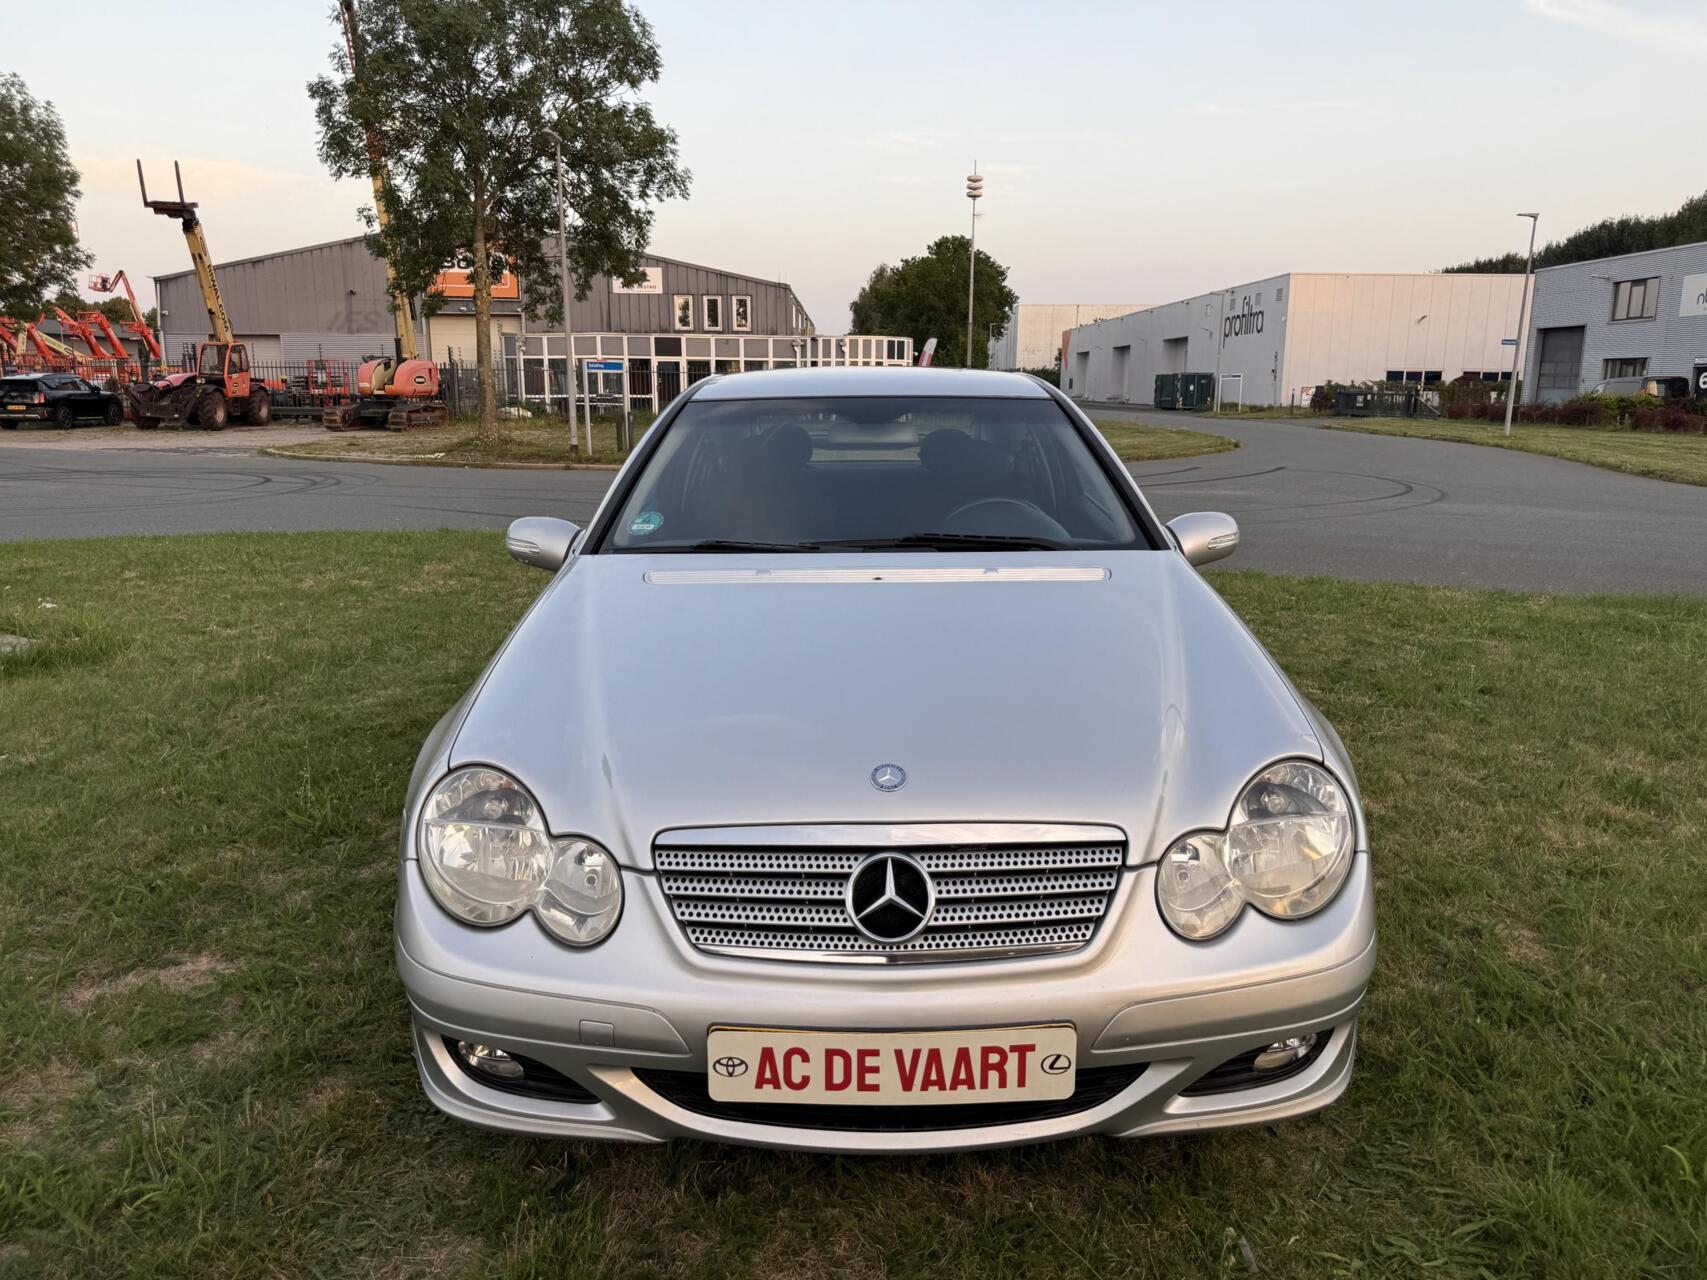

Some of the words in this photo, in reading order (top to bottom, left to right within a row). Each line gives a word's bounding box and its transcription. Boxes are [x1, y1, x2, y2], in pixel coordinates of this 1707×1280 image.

[1222, 295, 1264, 349] profiltra
[754, 1046, 811, 1091] AC
[825, 1048, 880, 1092] DE
[894, 1044, 1036, 1092] VAART
